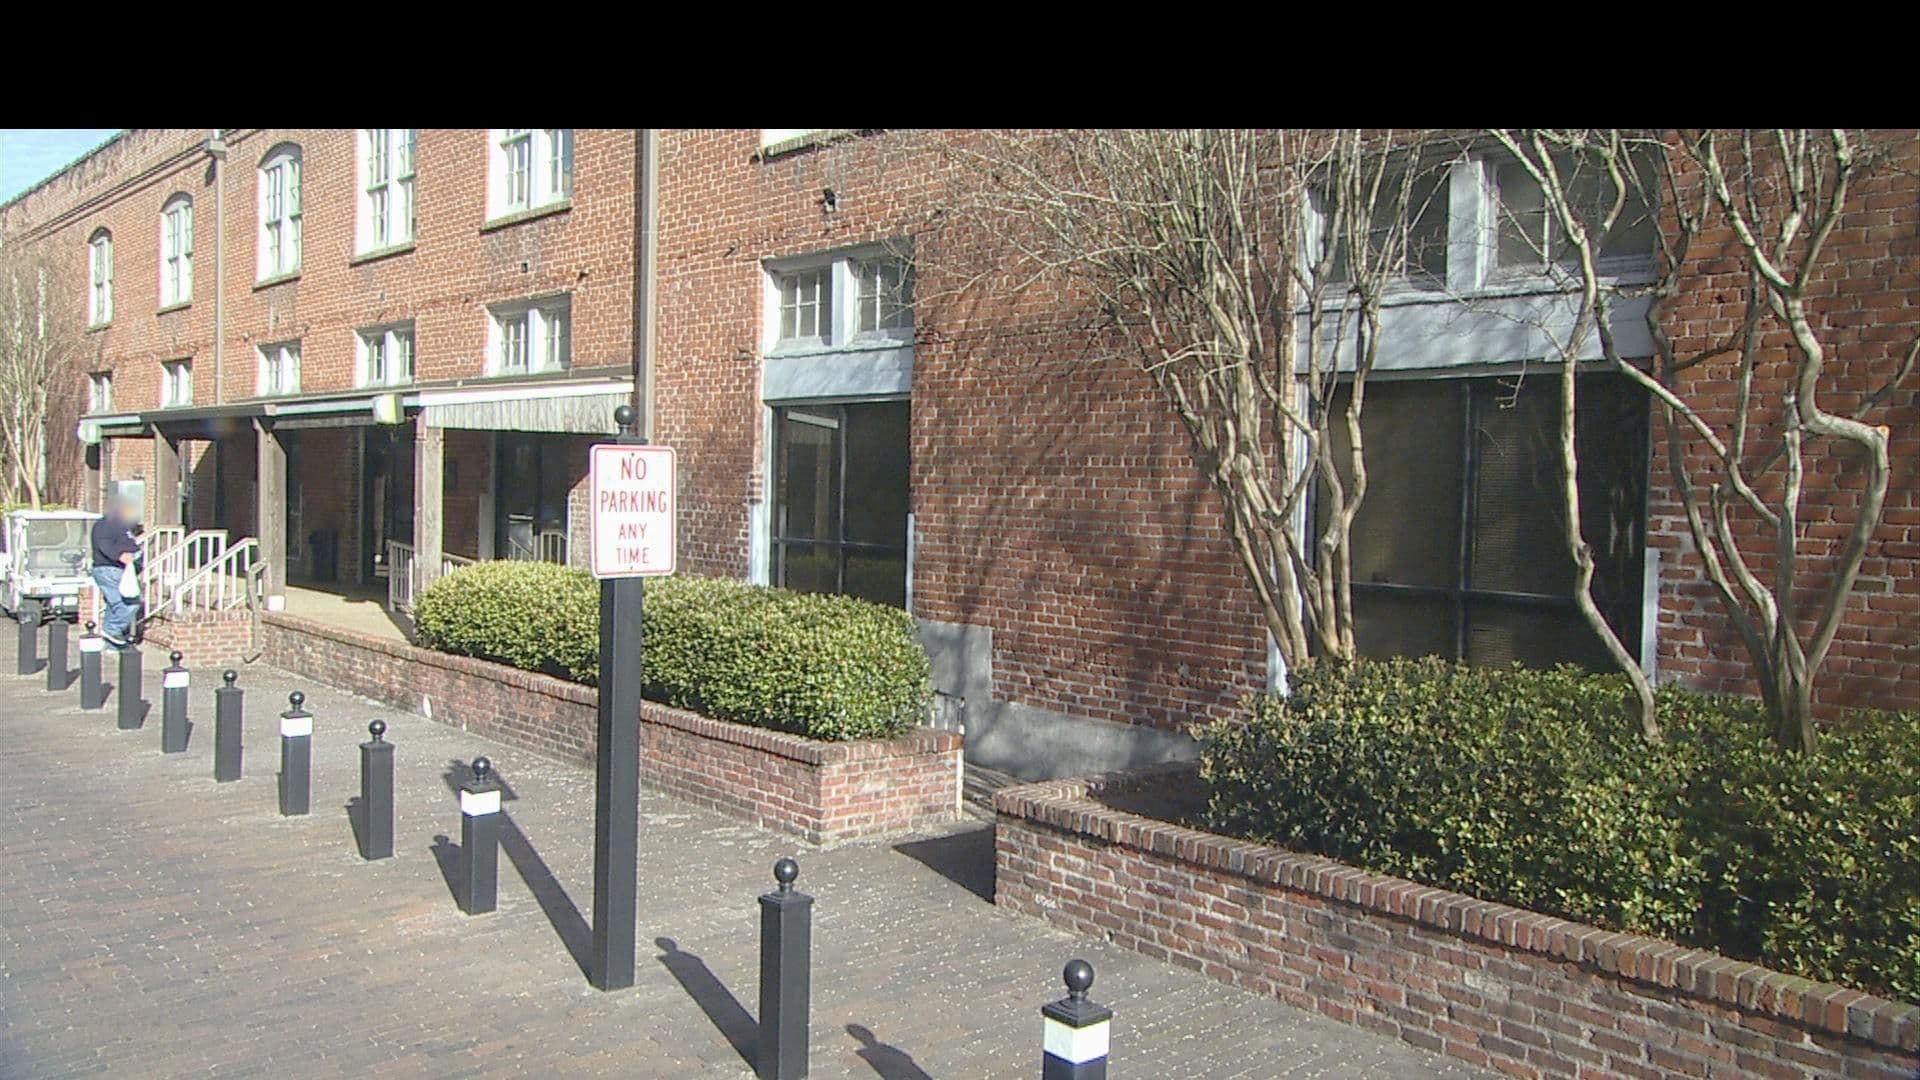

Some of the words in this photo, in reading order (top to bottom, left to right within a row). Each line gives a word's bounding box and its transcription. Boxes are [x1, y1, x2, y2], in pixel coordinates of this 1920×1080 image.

[621, 457, 647, 480] NO
[600, 490, 667, 513] PARKING
[618, 523, 648, 540] ANY
[616, 547, 650, 564] TIME
